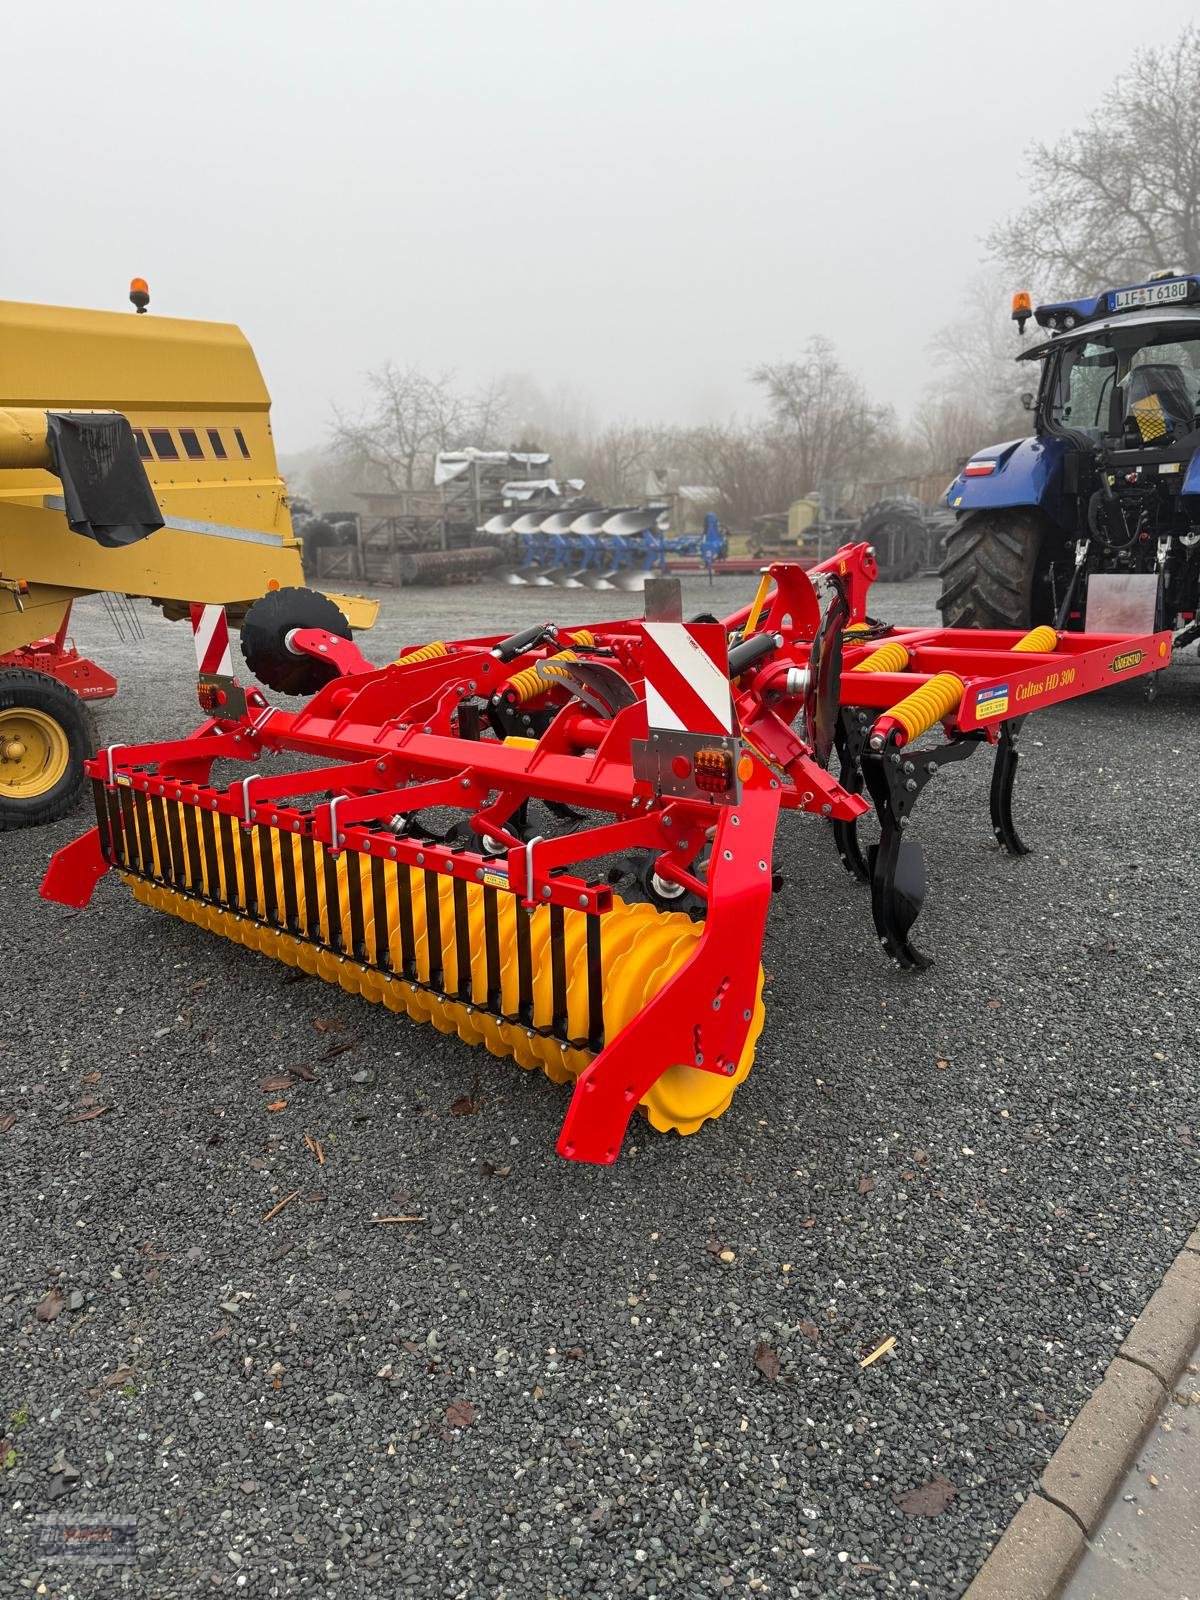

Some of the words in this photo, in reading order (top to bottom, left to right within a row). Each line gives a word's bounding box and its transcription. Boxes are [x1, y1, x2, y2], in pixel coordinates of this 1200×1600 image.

[1116, 291, 1138, 307] LIF
[1147, 288, 1154, 302] T
[1156, 283, 1186, 300] 6180
[1016, 680, 1044, 701] Cultus
[1045, 673, 1059, 691] HD
[1060, 668, 1076, 686] 300
